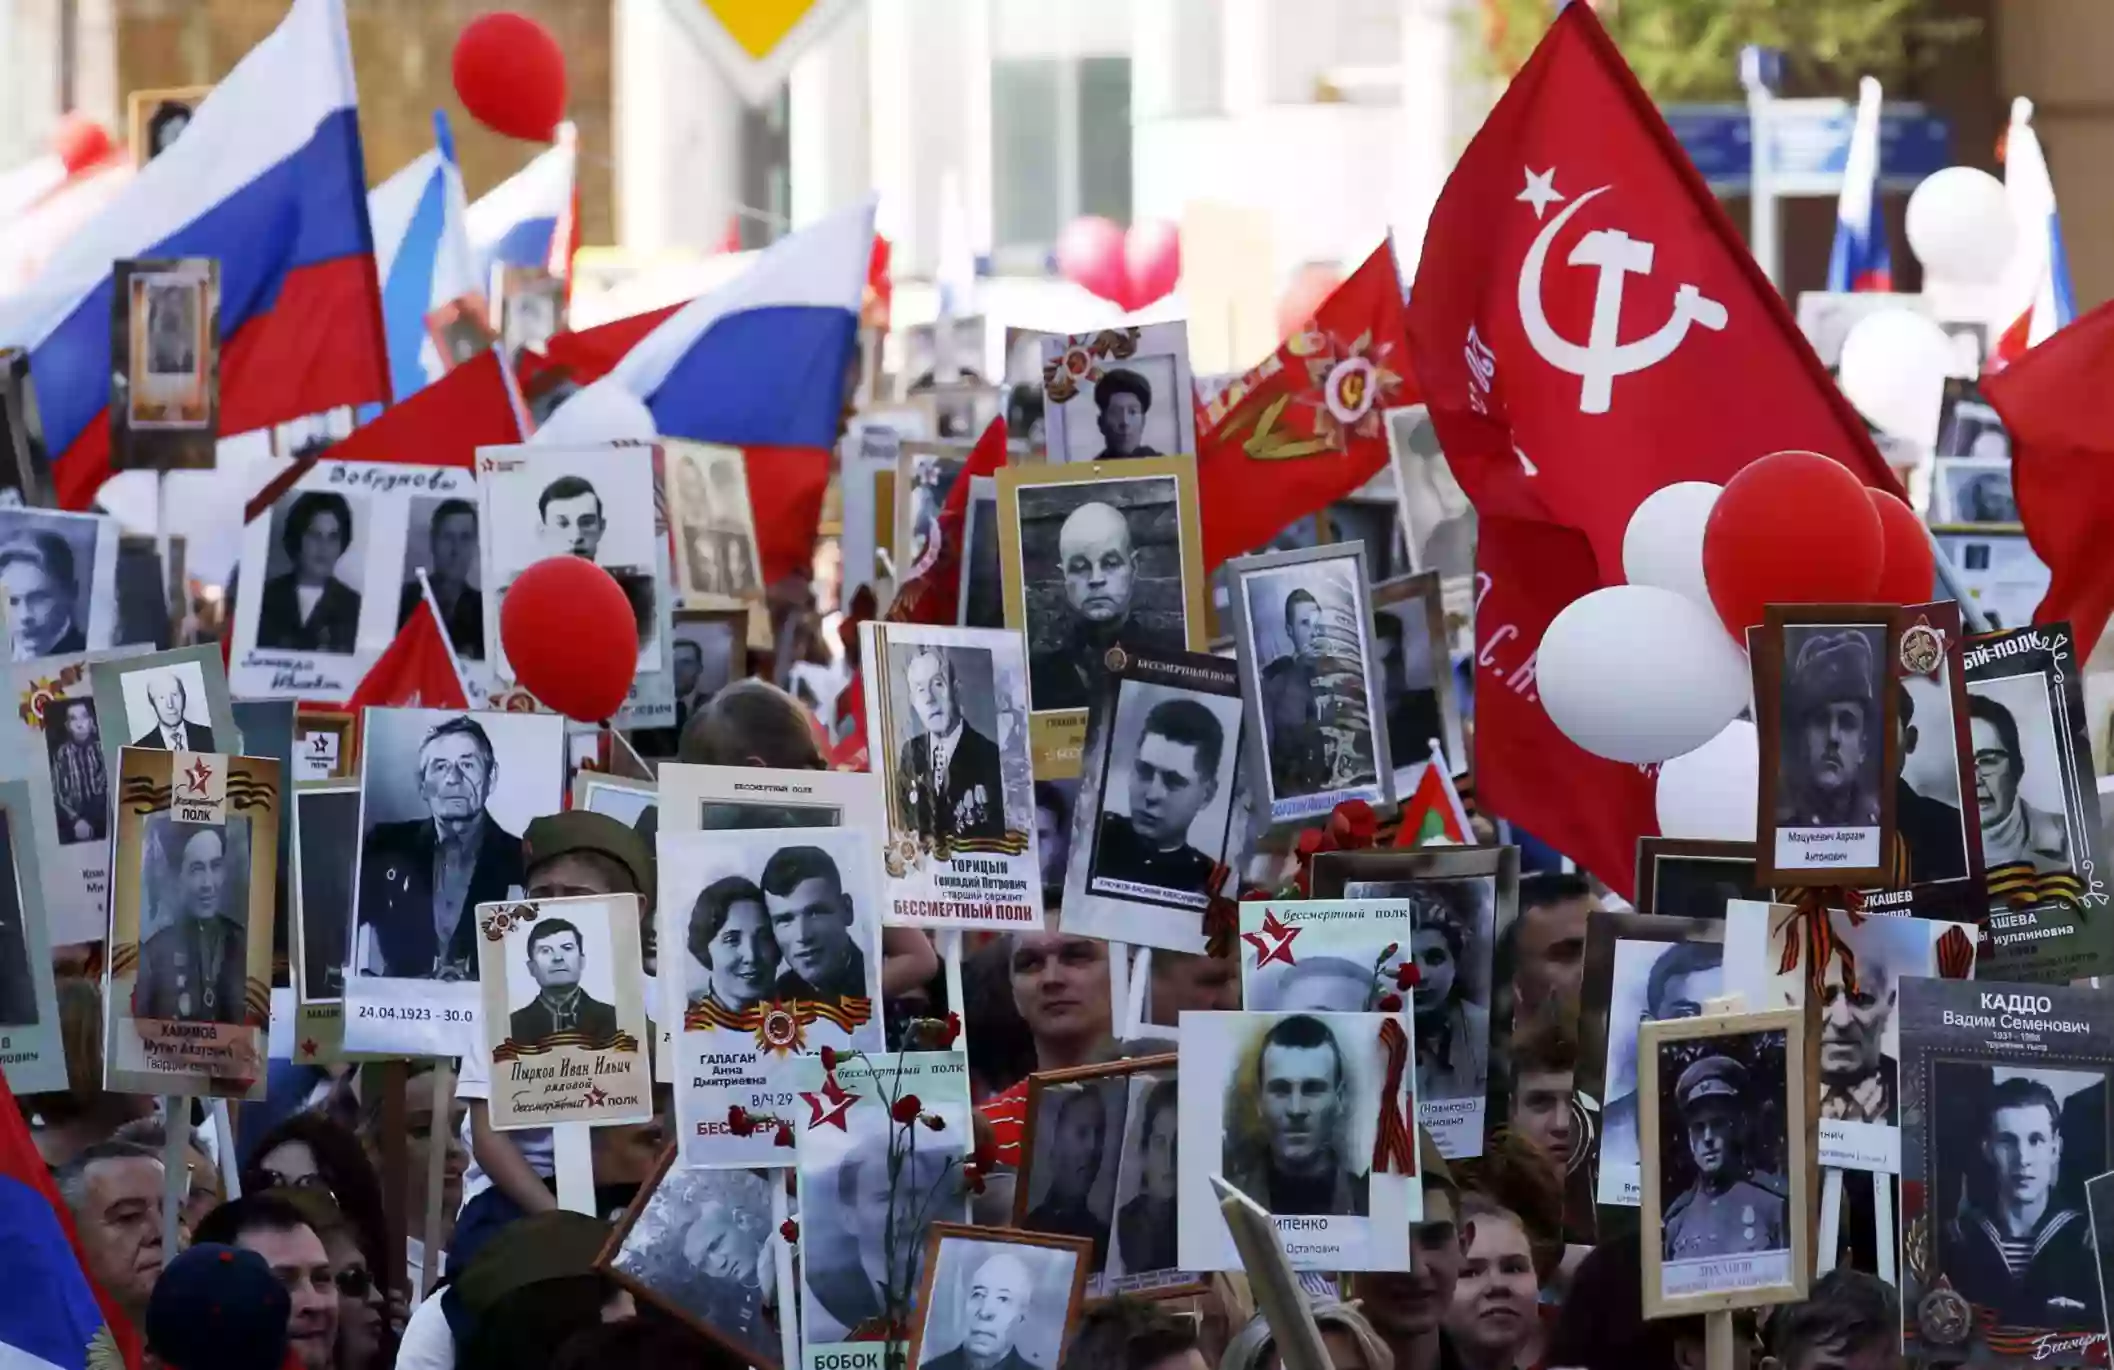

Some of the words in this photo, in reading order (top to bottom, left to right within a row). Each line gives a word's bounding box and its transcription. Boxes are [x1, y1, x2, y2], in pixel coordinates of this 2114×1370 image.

[951, 859, 1009, 875] ТОРИЦЫН
[934, 874, 980, 889] Геннадий
[982, 876, 1027, 890] Петрович
[943, 890, 982, 901] старший
[894, 900, 993, 920] БЕССМЕРТНЫЙ
[996, 906, 1033, 921] ПОЛК
[1284, 908, 1365, 922] бессмертный
[1375, 909, 1408, 919] полк
[1980, 992, 2051, 1015] КАДДО
[359, 1006, 431, 1021] 24.04.1923
[1943, 1010, 1996, 1028] Вадим
[2000, 1014, 2090, 1034] Семенович
[700, 1053, 757, 1065] ГАЛАГАН
[511, 1061, 555, 1084] Пырков
[560, 1057, 590, 1077] Иван
[594, 1055, 632, 1075] Ильич
[712, 1066, 743, 1076] Анна
[931, 1064, 965, 1074] полк
[544, 1079, 592, 1095] рядовой
[693, 1077, 767, 1089] Дмитриевна
[1286, 1243, 1340, 1254] Остапович
[814, 1353, 878, 1370] БОБОК
